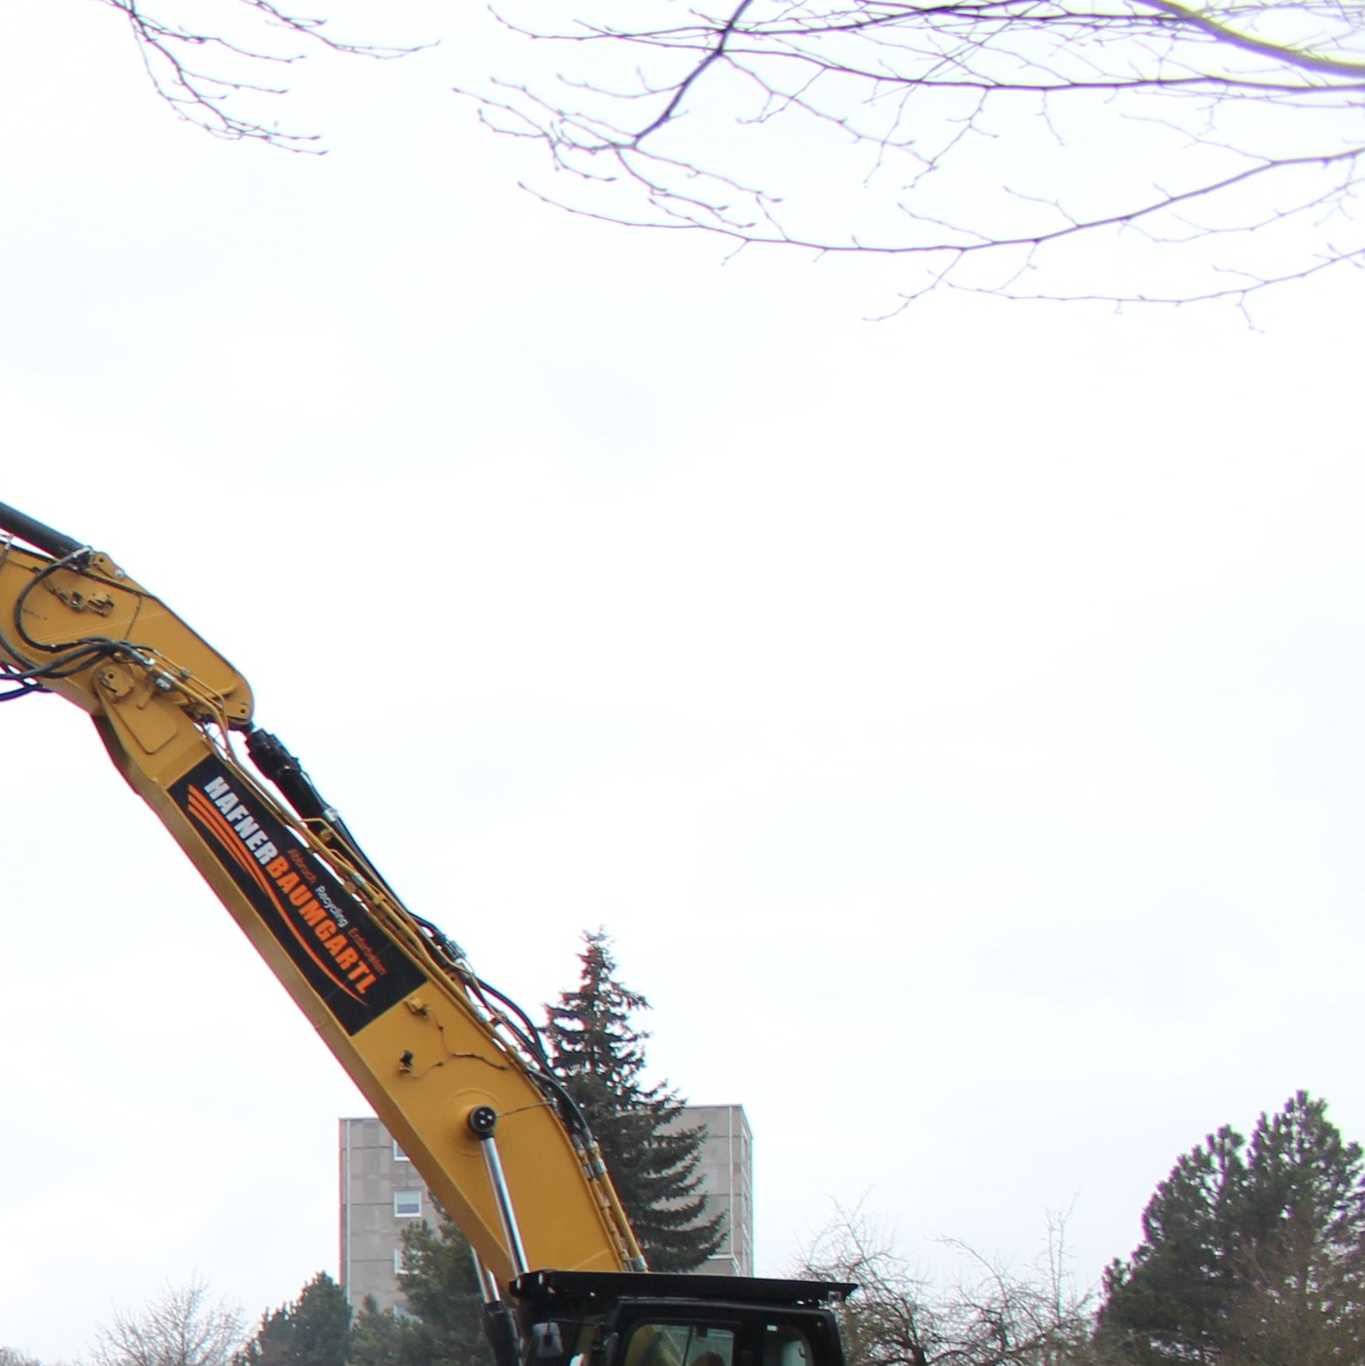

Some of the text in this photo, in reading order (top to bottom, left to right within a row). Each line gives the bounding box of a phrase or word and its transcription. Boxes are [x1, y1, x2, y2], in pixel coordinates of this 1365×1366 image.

[287, 847, 388, 976] Abbruch Recycling Erdarbeiten
